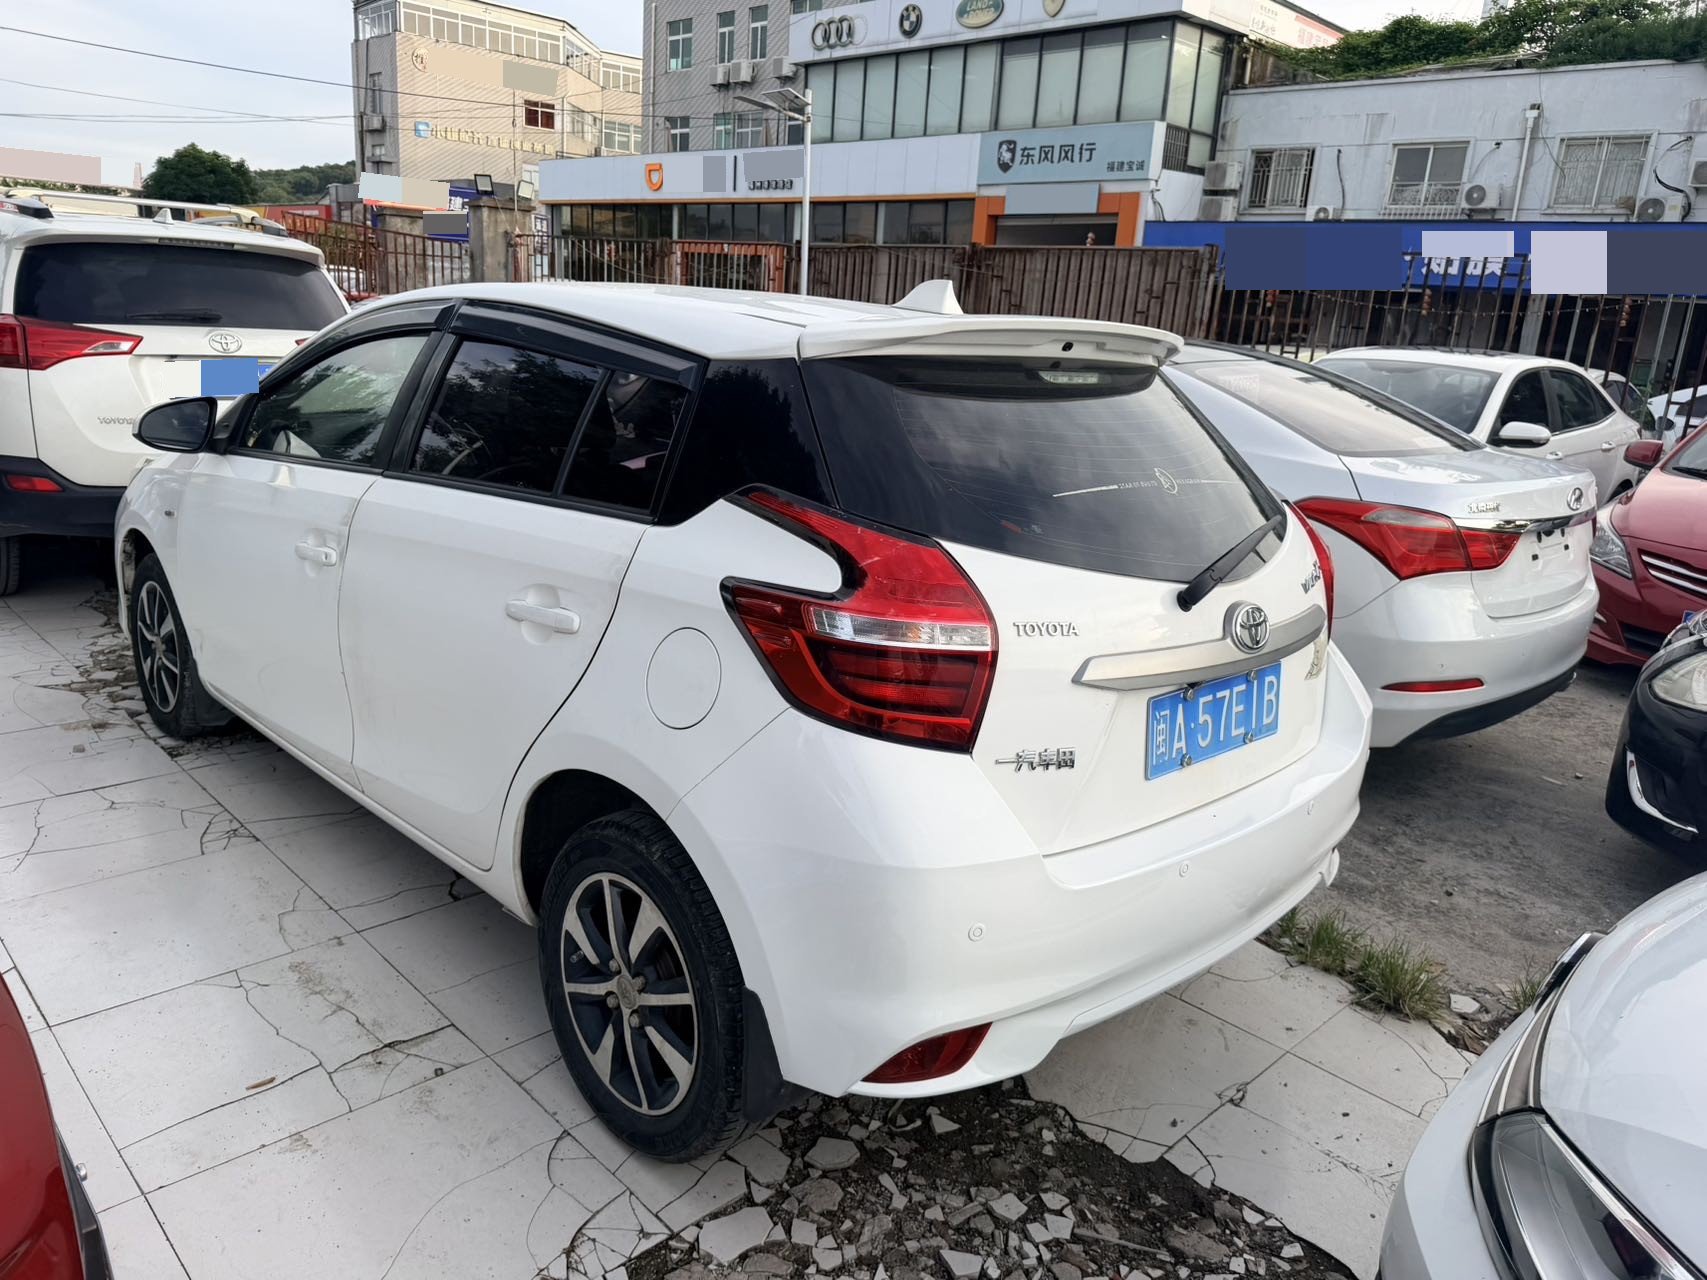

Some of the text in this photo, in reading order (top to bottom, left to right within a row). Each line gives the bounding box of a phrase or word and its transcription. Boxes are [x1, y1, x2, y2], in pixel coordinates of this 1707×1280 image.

[1019, 142, 1097, 166] 东风风行
[1106, 160, 1145, 172] 福建宝诚
[1013, 622, 1080, 637] TOYOTA
